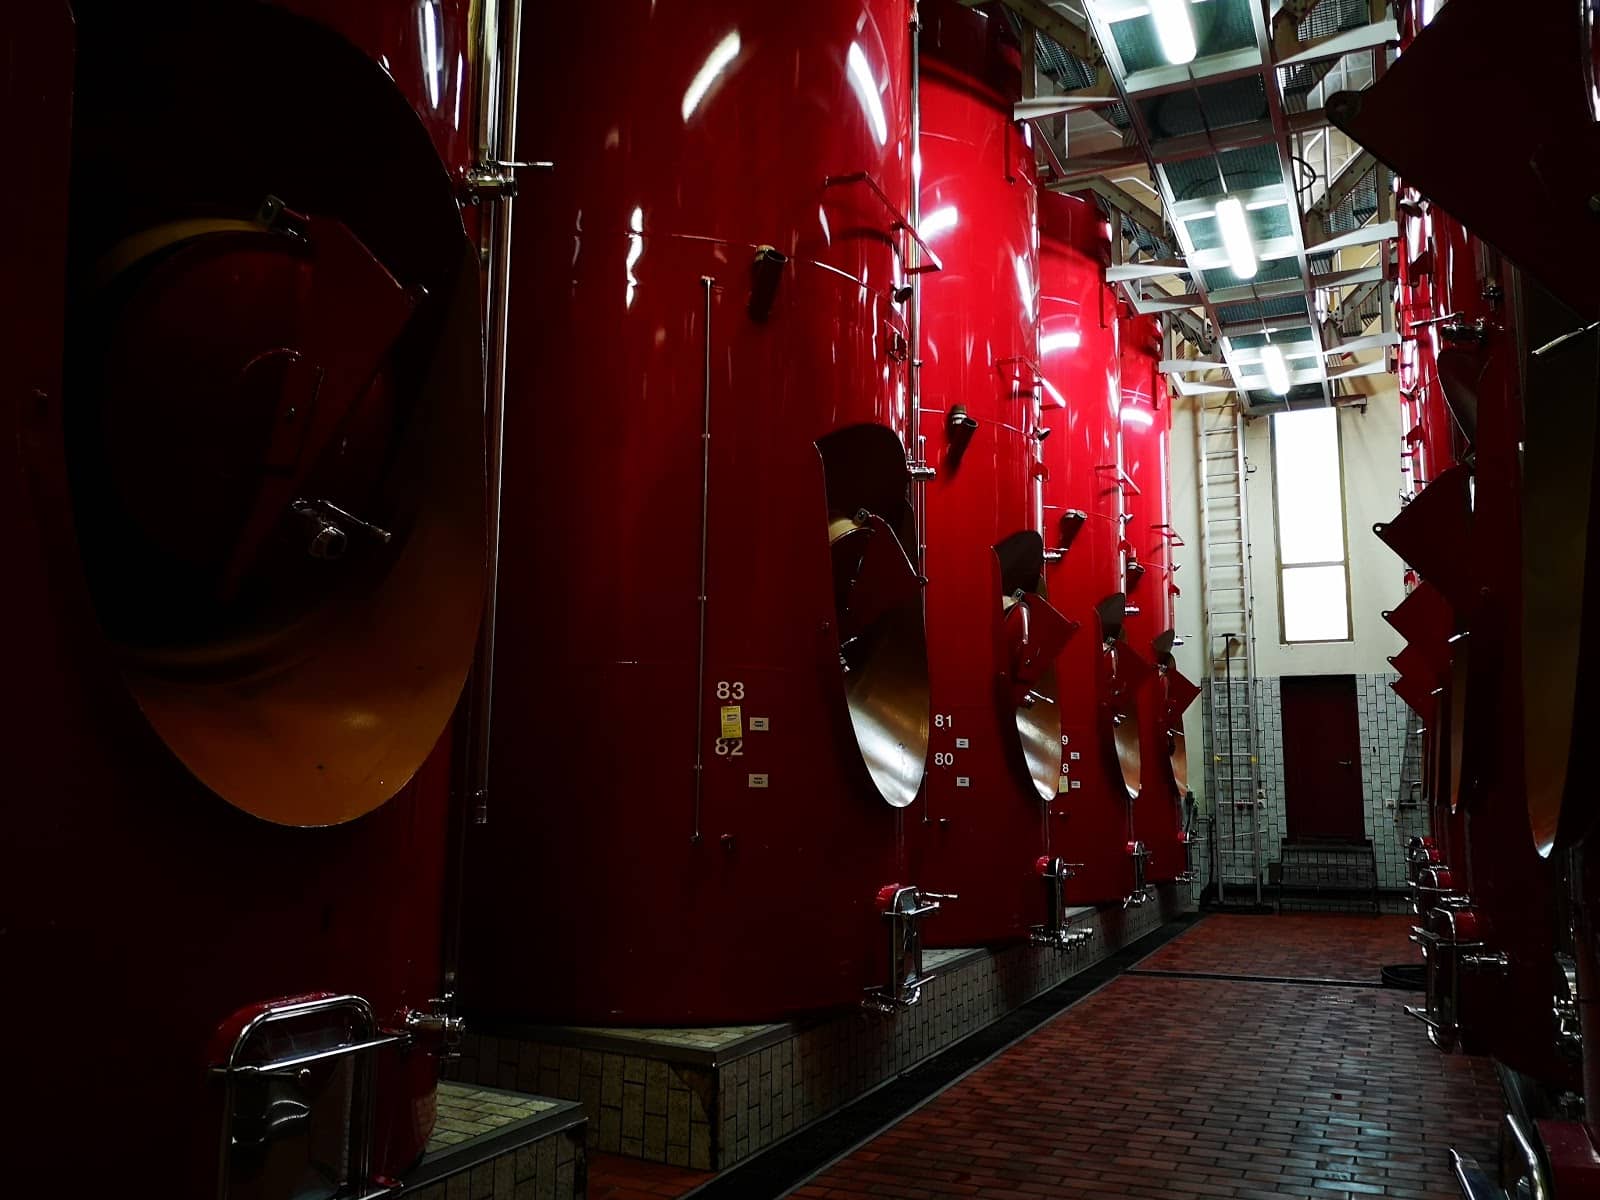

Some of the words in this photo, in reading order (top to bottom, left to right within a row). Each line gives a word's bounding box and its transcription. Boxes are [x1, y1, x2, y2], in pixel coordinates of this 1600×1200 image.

[716, 681, 745, 700] 83
[934, 714, 952, 728] 81
[715, 737, 744, 756] 82
[1061, 735, 1069, 746] 9
[934, 752, 954, 766] 80
[1062, 763, 1069, 773] 8
